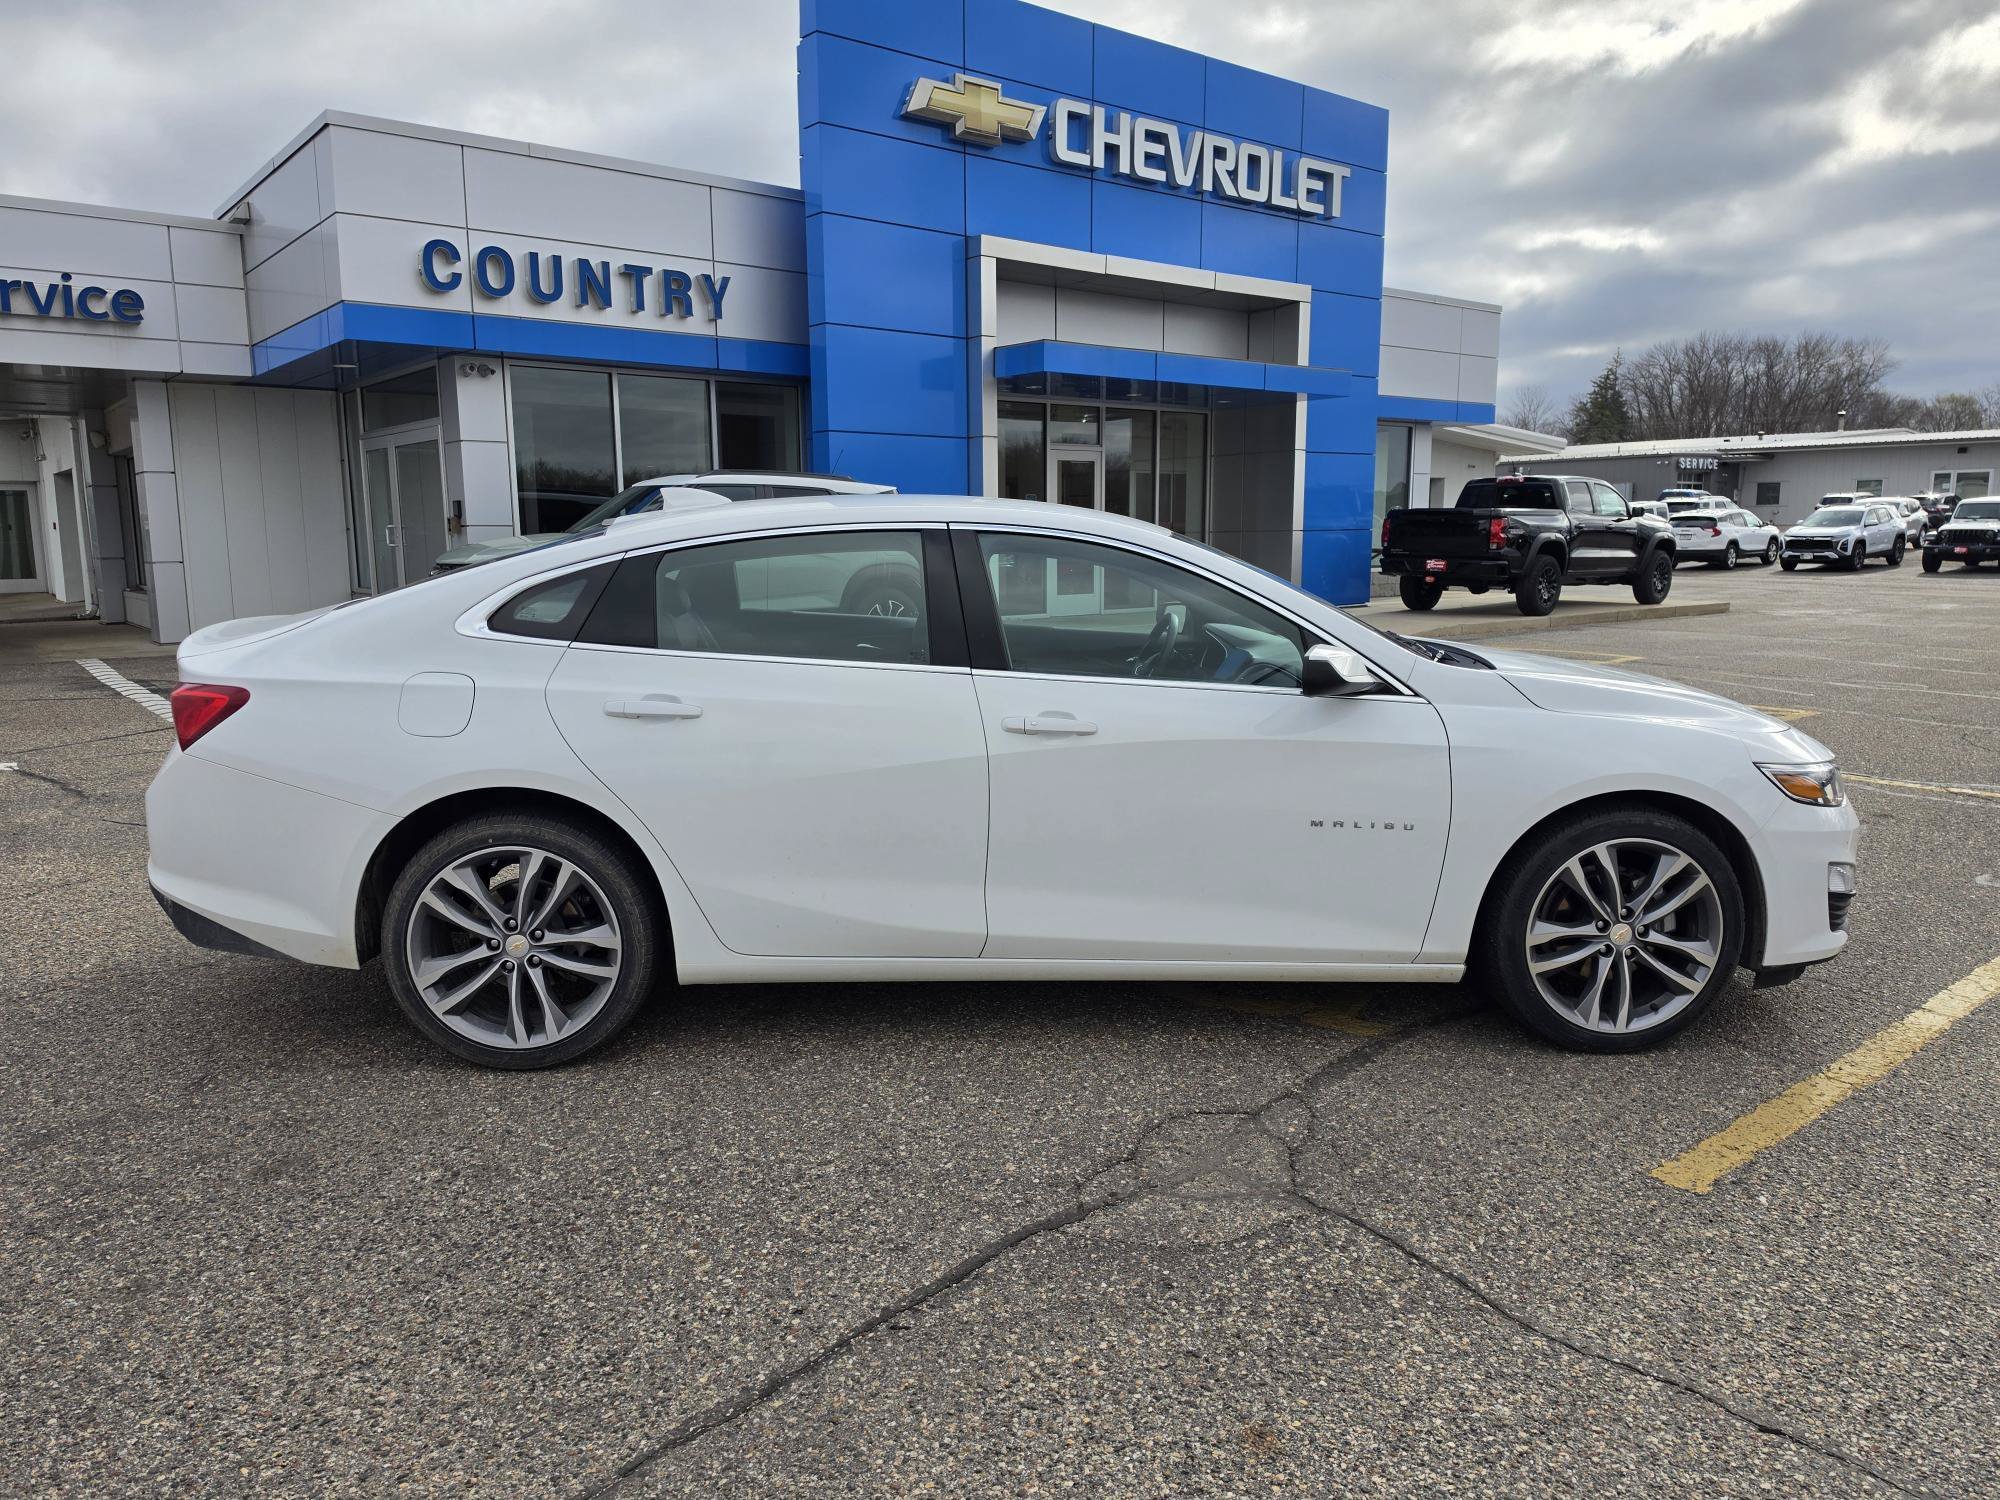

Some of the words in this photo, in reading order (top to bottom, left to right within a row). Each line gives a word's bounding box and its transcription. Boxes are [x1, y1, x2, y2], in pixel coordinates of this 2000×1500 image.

[1052, 98, 1350, 218] CHEVROLET
[0, 273, 144, 324] rvice
[418, 239, 731, 320] COUNTRY
[1679, 457, 1719, 470] SERVICE
[1310, 819, 1414, 831] MALIBU
